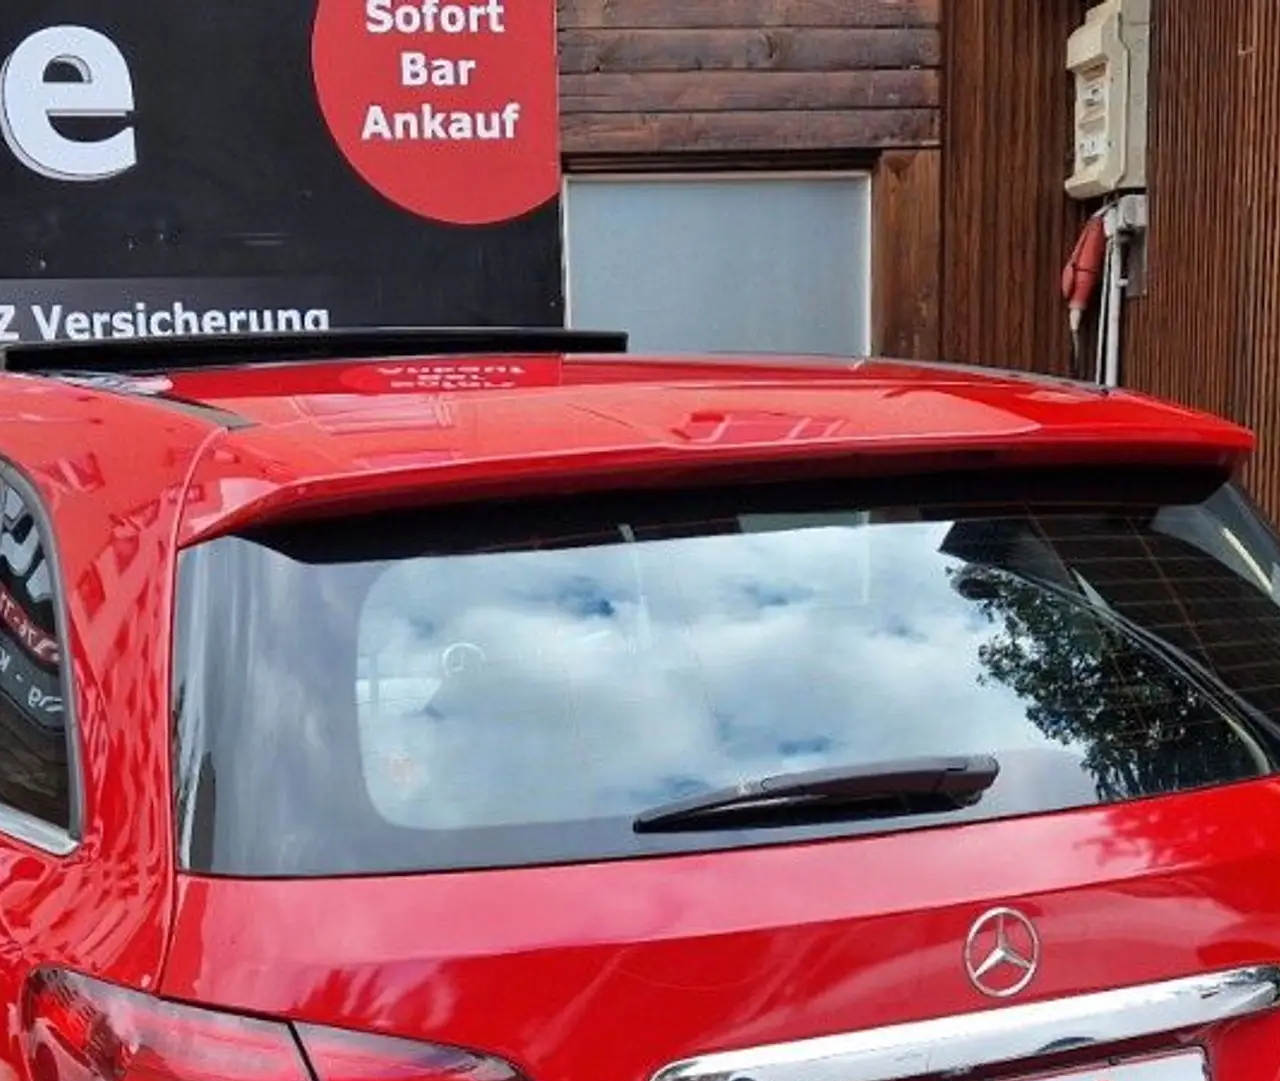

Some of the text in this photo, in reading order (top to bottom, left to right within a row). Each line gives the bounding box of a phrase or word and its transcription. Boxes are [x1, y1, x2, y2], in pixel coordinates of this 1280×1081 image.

[365, 0, 505, 33] Sofort
[400, 52, 476, 86] Bar
[361, 103, 520, 140] Ankauf
[32, 302, 330, 342] Versicherung
